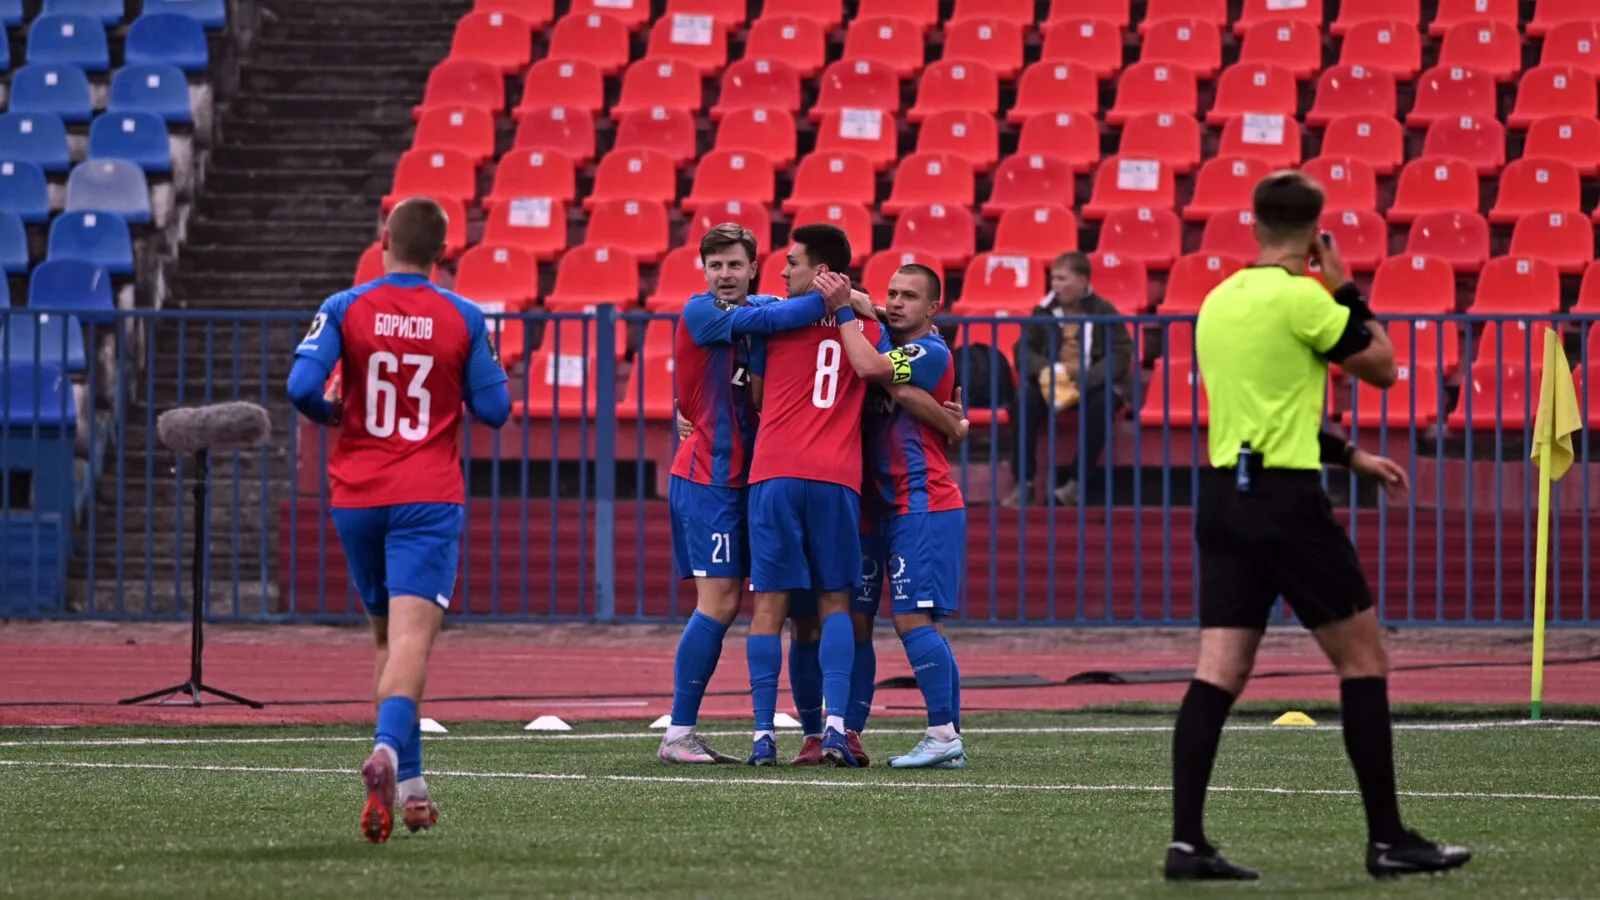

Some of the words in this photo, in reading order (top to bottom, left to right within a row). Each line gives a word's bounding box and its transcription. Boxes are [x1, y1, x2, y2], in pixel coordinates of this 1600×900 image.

[374, 313, 433, 340] БОРИСОВ
[365, 351, 435, 441] 63
[812, 339, 842, 409] 8
[711, 532, 730, 563] 21
